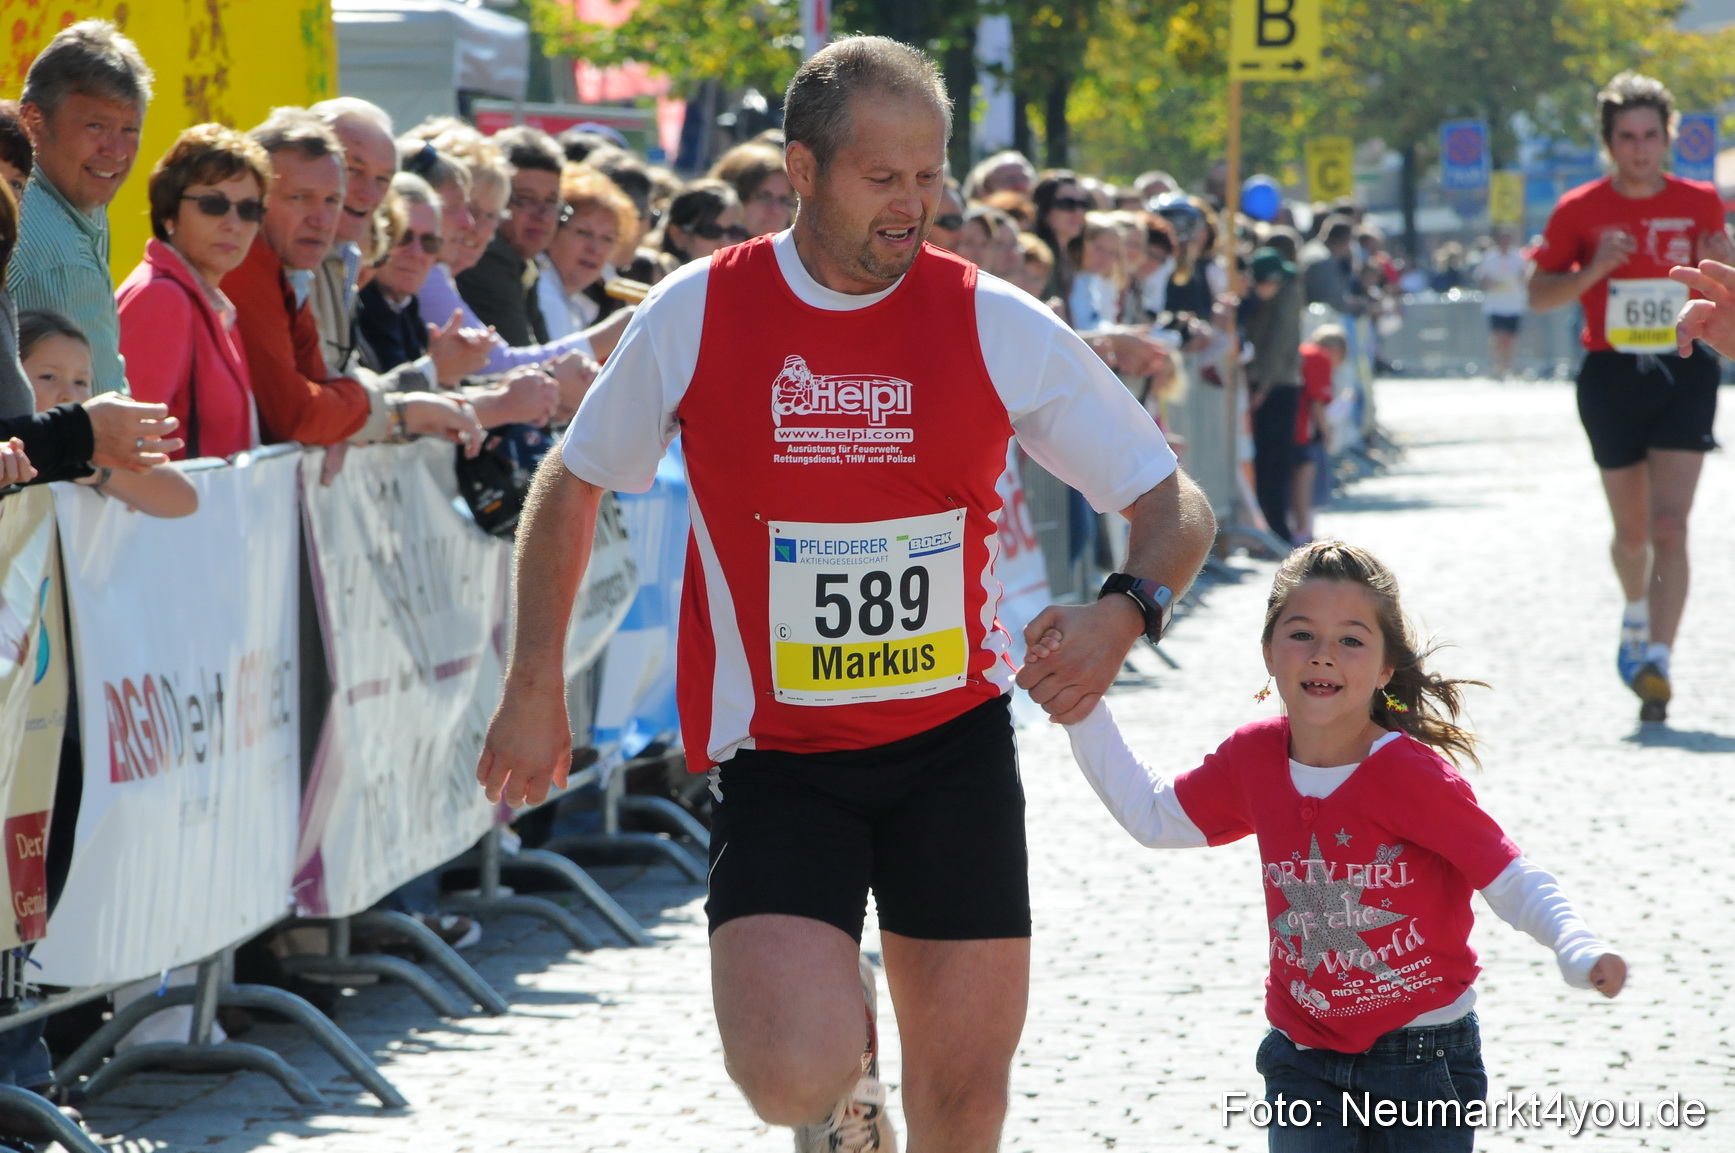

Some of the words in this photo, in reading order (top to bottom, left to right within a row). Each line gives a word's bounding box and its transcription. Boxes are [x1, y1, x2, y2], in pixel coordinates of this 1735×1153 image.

[1257, 0, 1296, 48] B
[1319, 160, 1343, 192] C
[1625, 299, 1673, 326] 696
[811, 379, 909, 424] Helpi
[778, 428, 911, 441] www.helpi.com
[787, 444, 836, 455] Ausrüstung
[838, 444, 851, 453] für
[853, 445, 902, 454] Feuerwehr,
[773, 454, 843, 465] Rettungsdienst,
[845, 455, 866, 463] THW
[868, 455, 884, 463] und
[887, 455, 916, 463] Polizei
[800, 538, 888, 555] PFLEIDERER
[909, 532, 952, 551] BOCK
[800, 555, 889, 566] AKTIENGESELLSCHAFT
[815, 565, 930, 639] 589
[812, 643, 935, 680] Markus
[1346, 862, 1415, 890] GIRL
[1287, 911, 1315, 940] of
[1324, 891, 1381, 929] the
[1318, 917, 1426, 974] World
[1343, 979, 1364, 988] GO
[1369, 956, 1432, 983] JOGGING
[1331, 988, 1361, 997] RIDE
